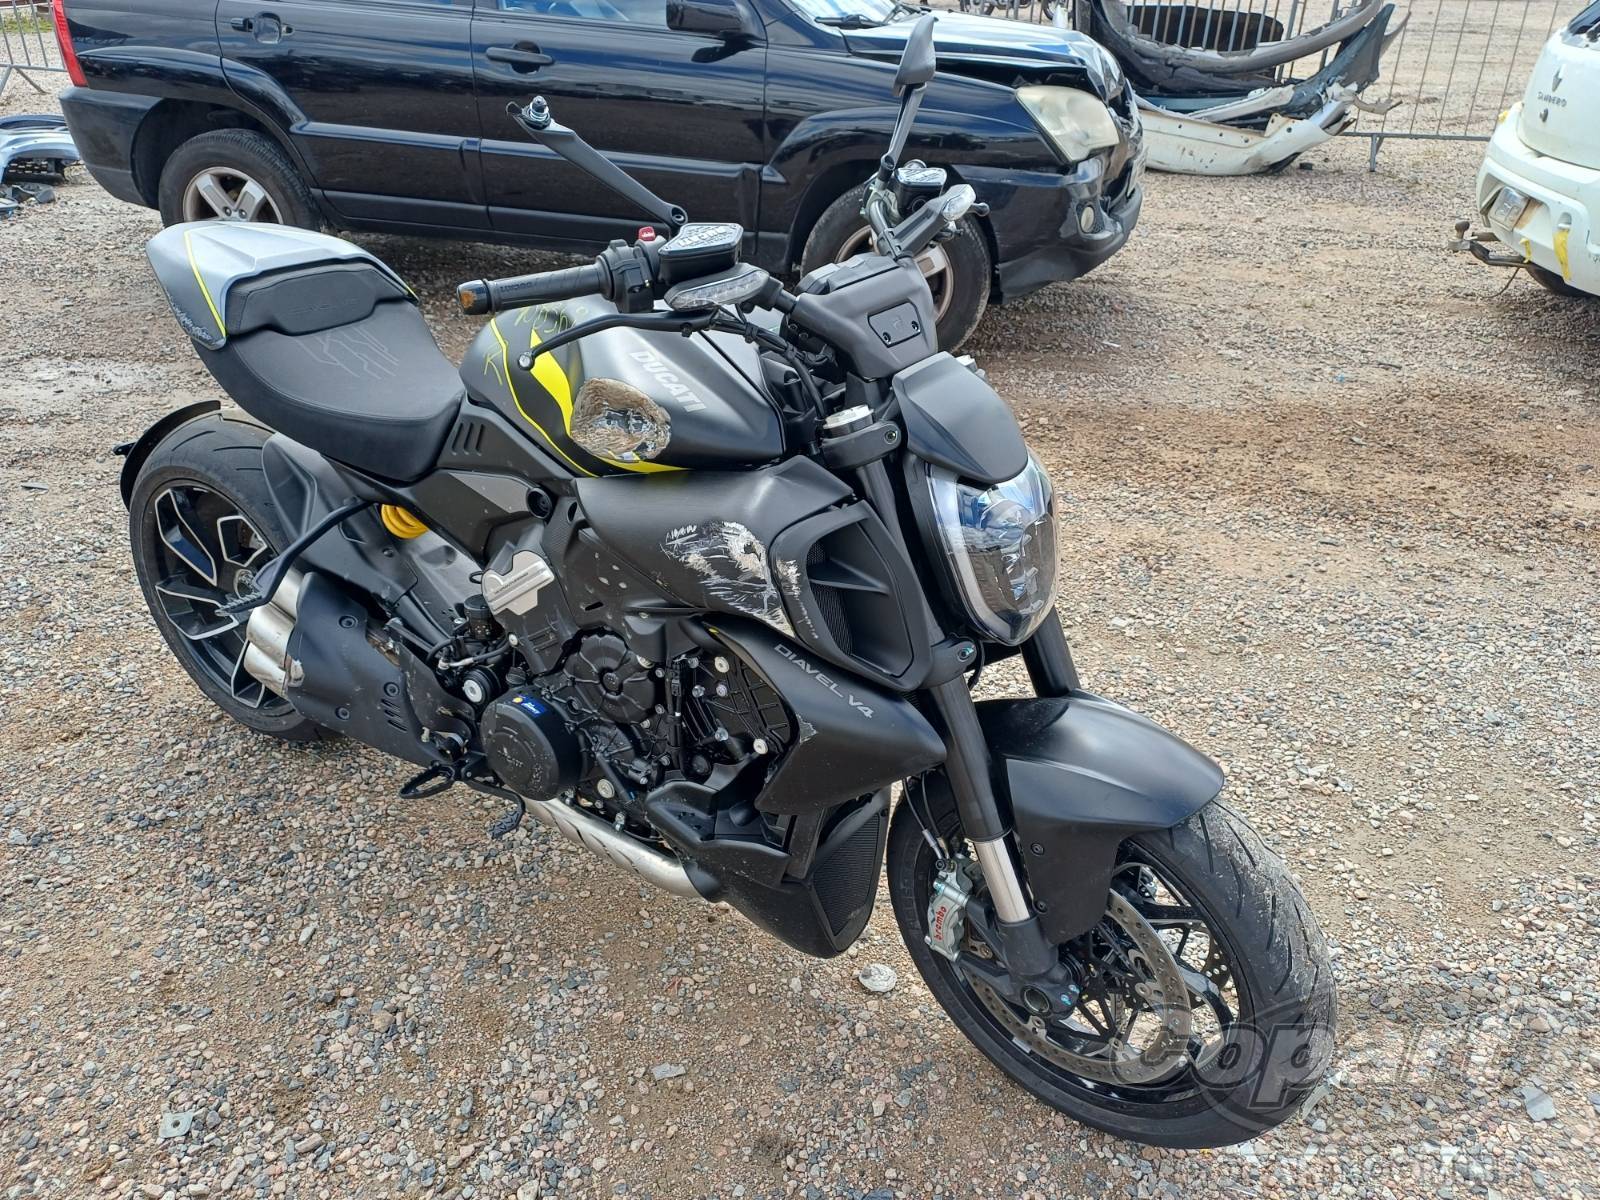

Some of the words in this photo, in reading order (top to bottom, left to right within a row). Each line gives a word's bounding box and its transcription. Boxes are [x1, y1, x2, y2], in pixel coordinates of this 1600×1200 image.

[631, 349, 708, 413] DUCATI
[774, 643, 844, 698] DIAVEL
[848, 694, 875, 719] V4
[934, 906, 948, 941] brembo
